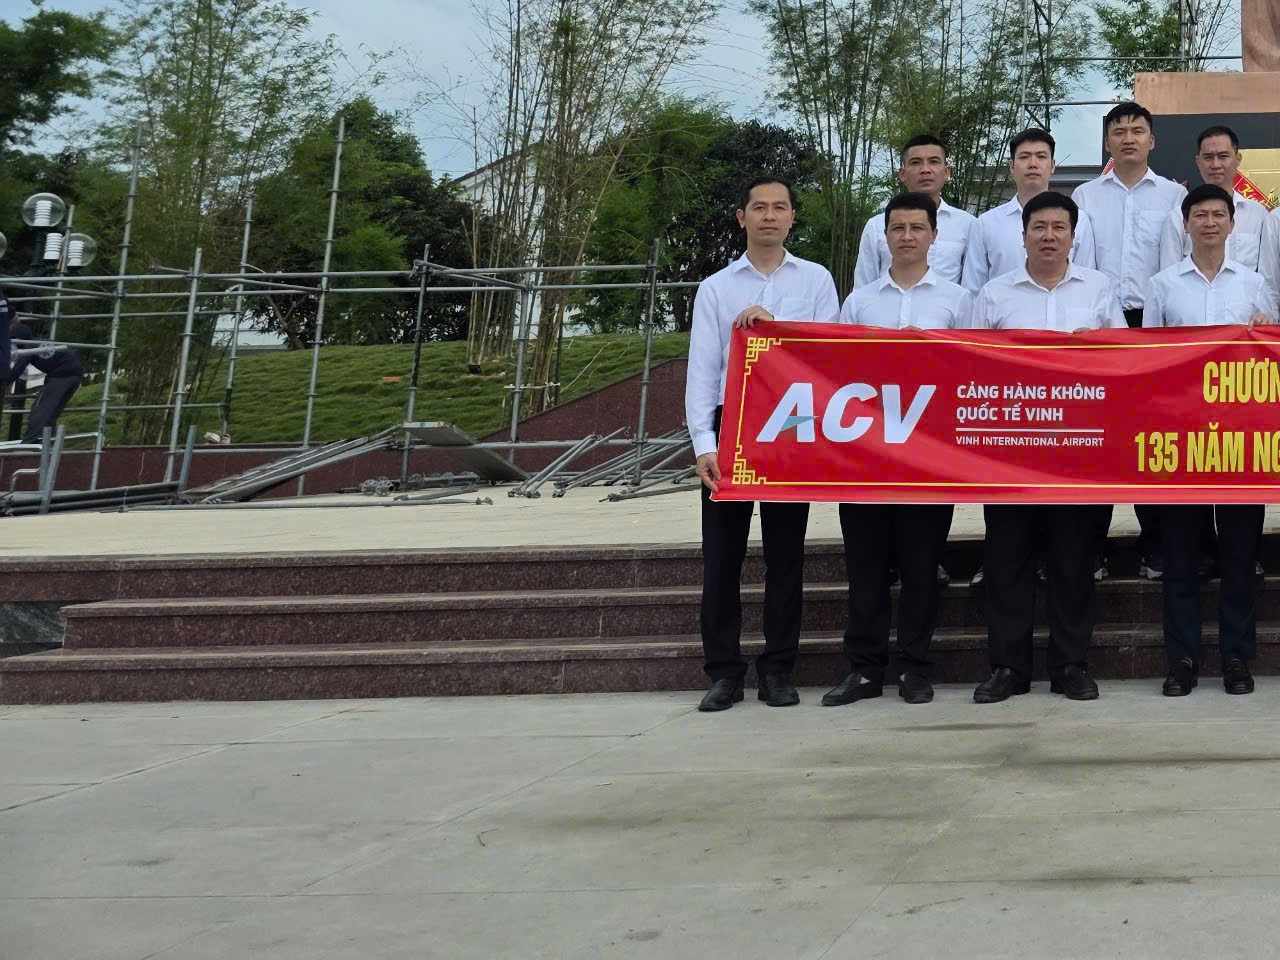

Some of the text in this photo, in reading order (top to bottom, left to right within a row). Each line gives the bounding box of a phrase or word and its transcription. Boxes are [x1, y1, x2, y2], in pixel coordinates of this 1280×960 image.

[956, 381, 1106, 401] CẢNG HÀNG KHÔNG
[756, 382, 936, 444] ACV
[956, 402, 1064, 421] QUỐC TẾ VINH
[956, 436, 1105, 447] VINH INTERNATIONAL AIRPORT
[1134, 431, 1179, 472] 135
[1186, 422, 1245, 473] NĂM
